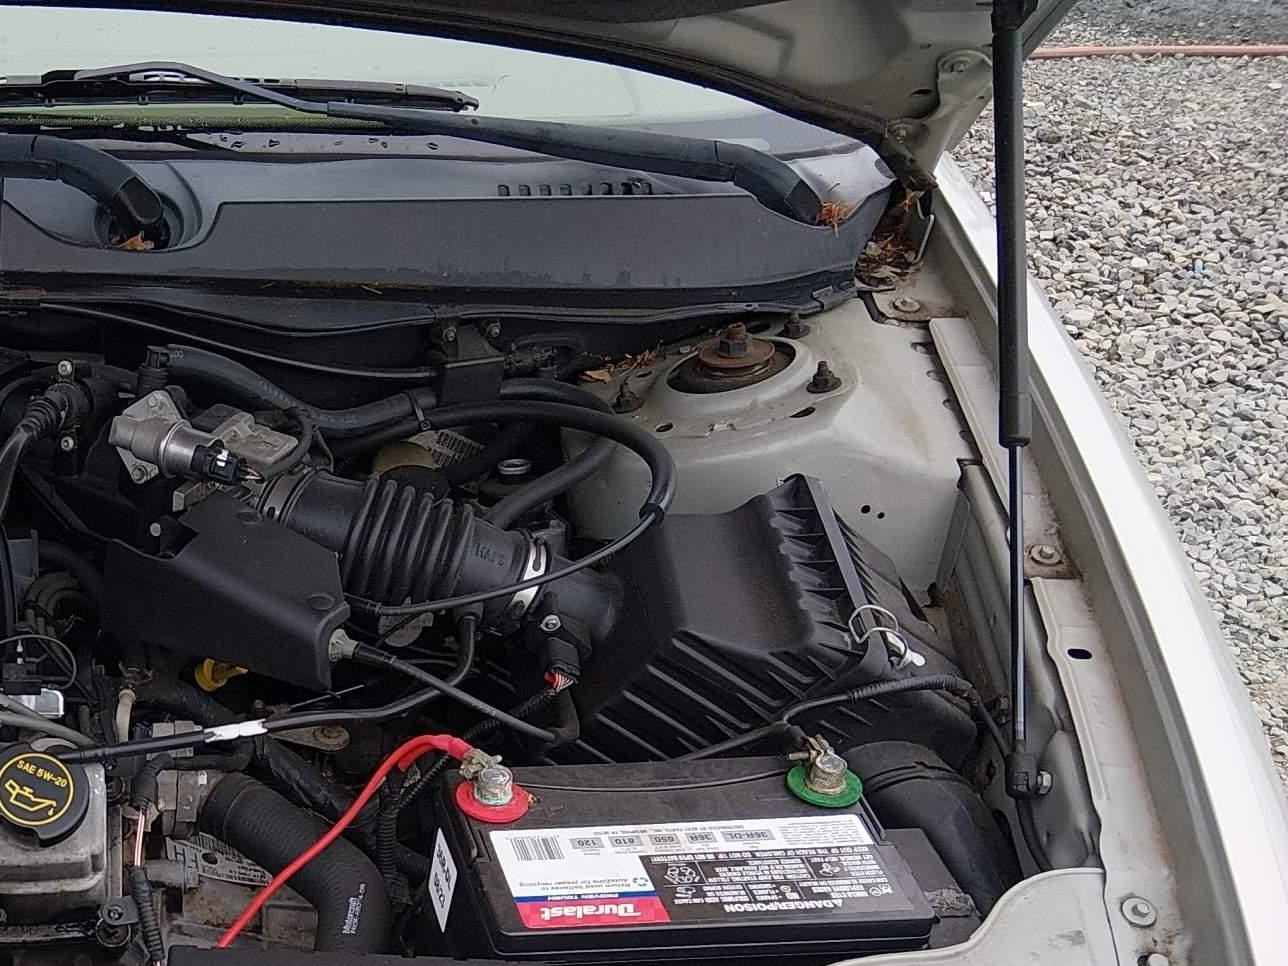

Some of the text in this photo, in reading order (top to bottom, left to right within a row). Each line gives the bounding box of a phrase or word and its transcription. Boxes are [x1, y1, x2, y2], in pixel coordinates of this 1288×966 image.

[16, 760, 68, 788] SAE 5W-20
[688, 833, 713, 841] 36R
[725, 831, 769, 839] 36R-DL
[722, 899, 834, 911] DANGER/POISON
[541, 903, 642, 920] Duralast
